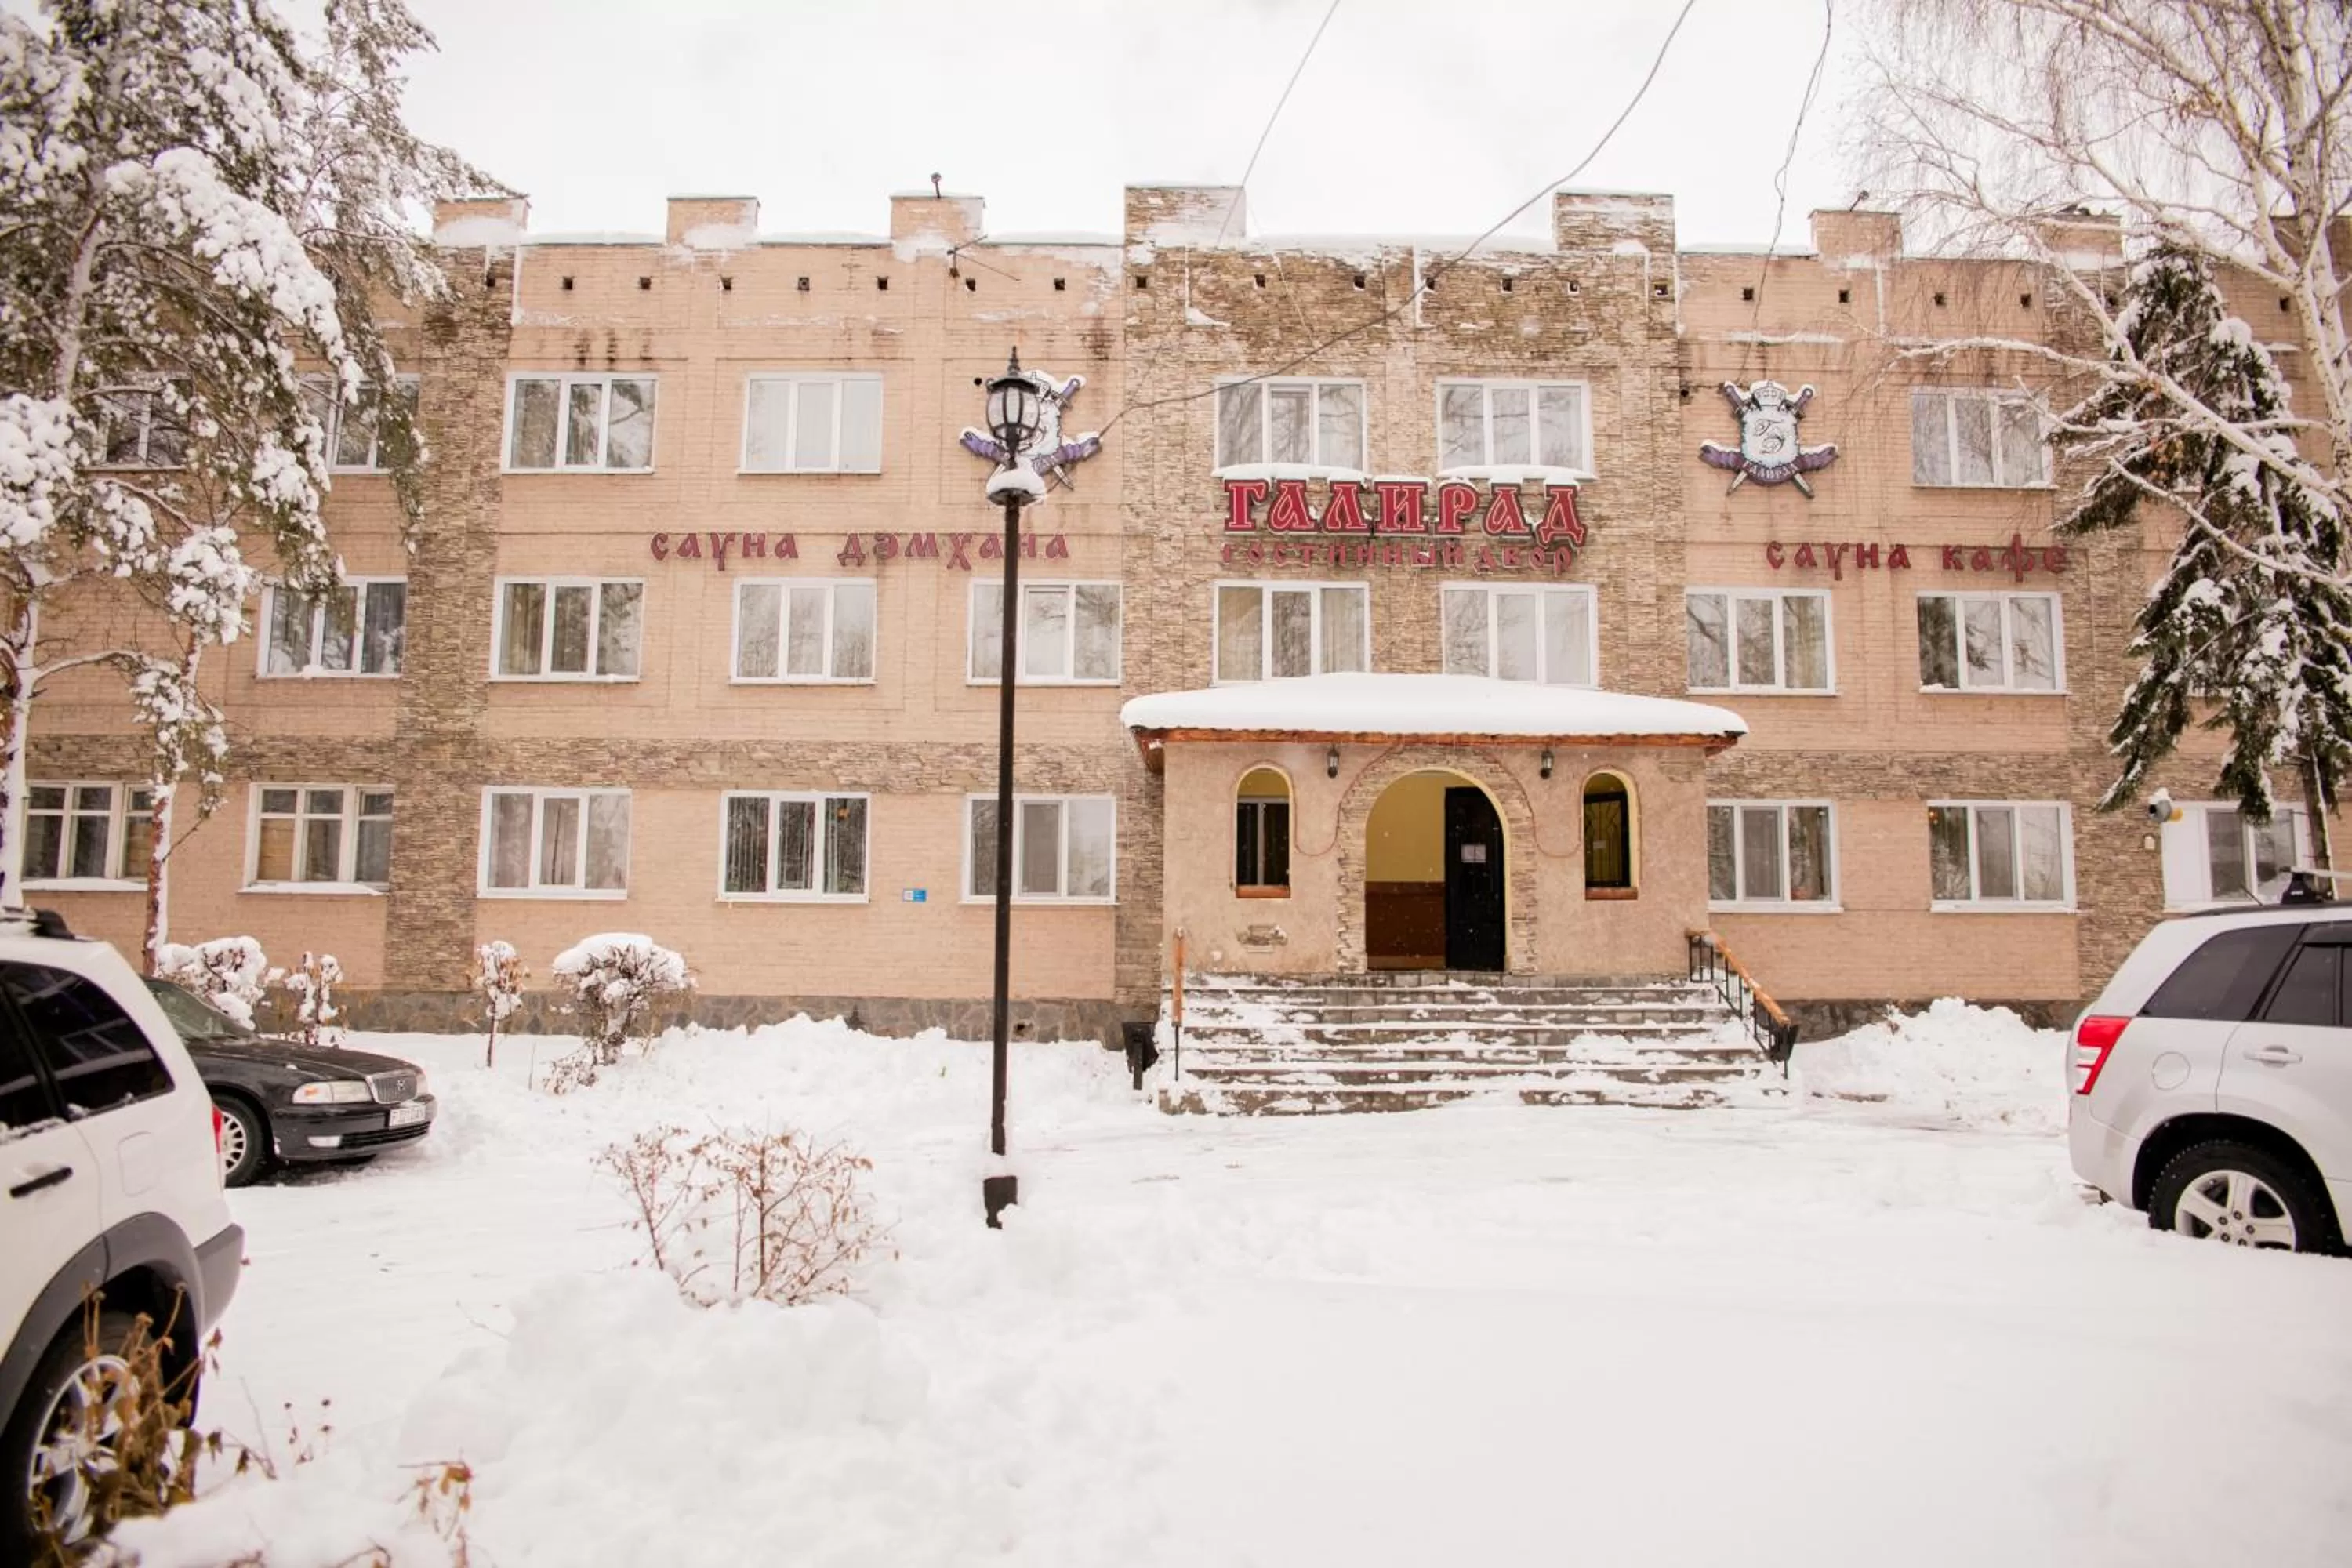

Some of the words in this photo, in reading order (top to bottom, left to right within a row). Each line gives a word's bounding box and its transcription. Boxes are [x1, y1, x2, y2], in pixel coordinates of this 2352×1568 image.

[1225, 480, 1588, 547] ГАЛИРАД
[649, 532, 799, 571] сауна
[1766, 540, 1911, 581] сауна
[1942, 533, 2070, 583] кафе
